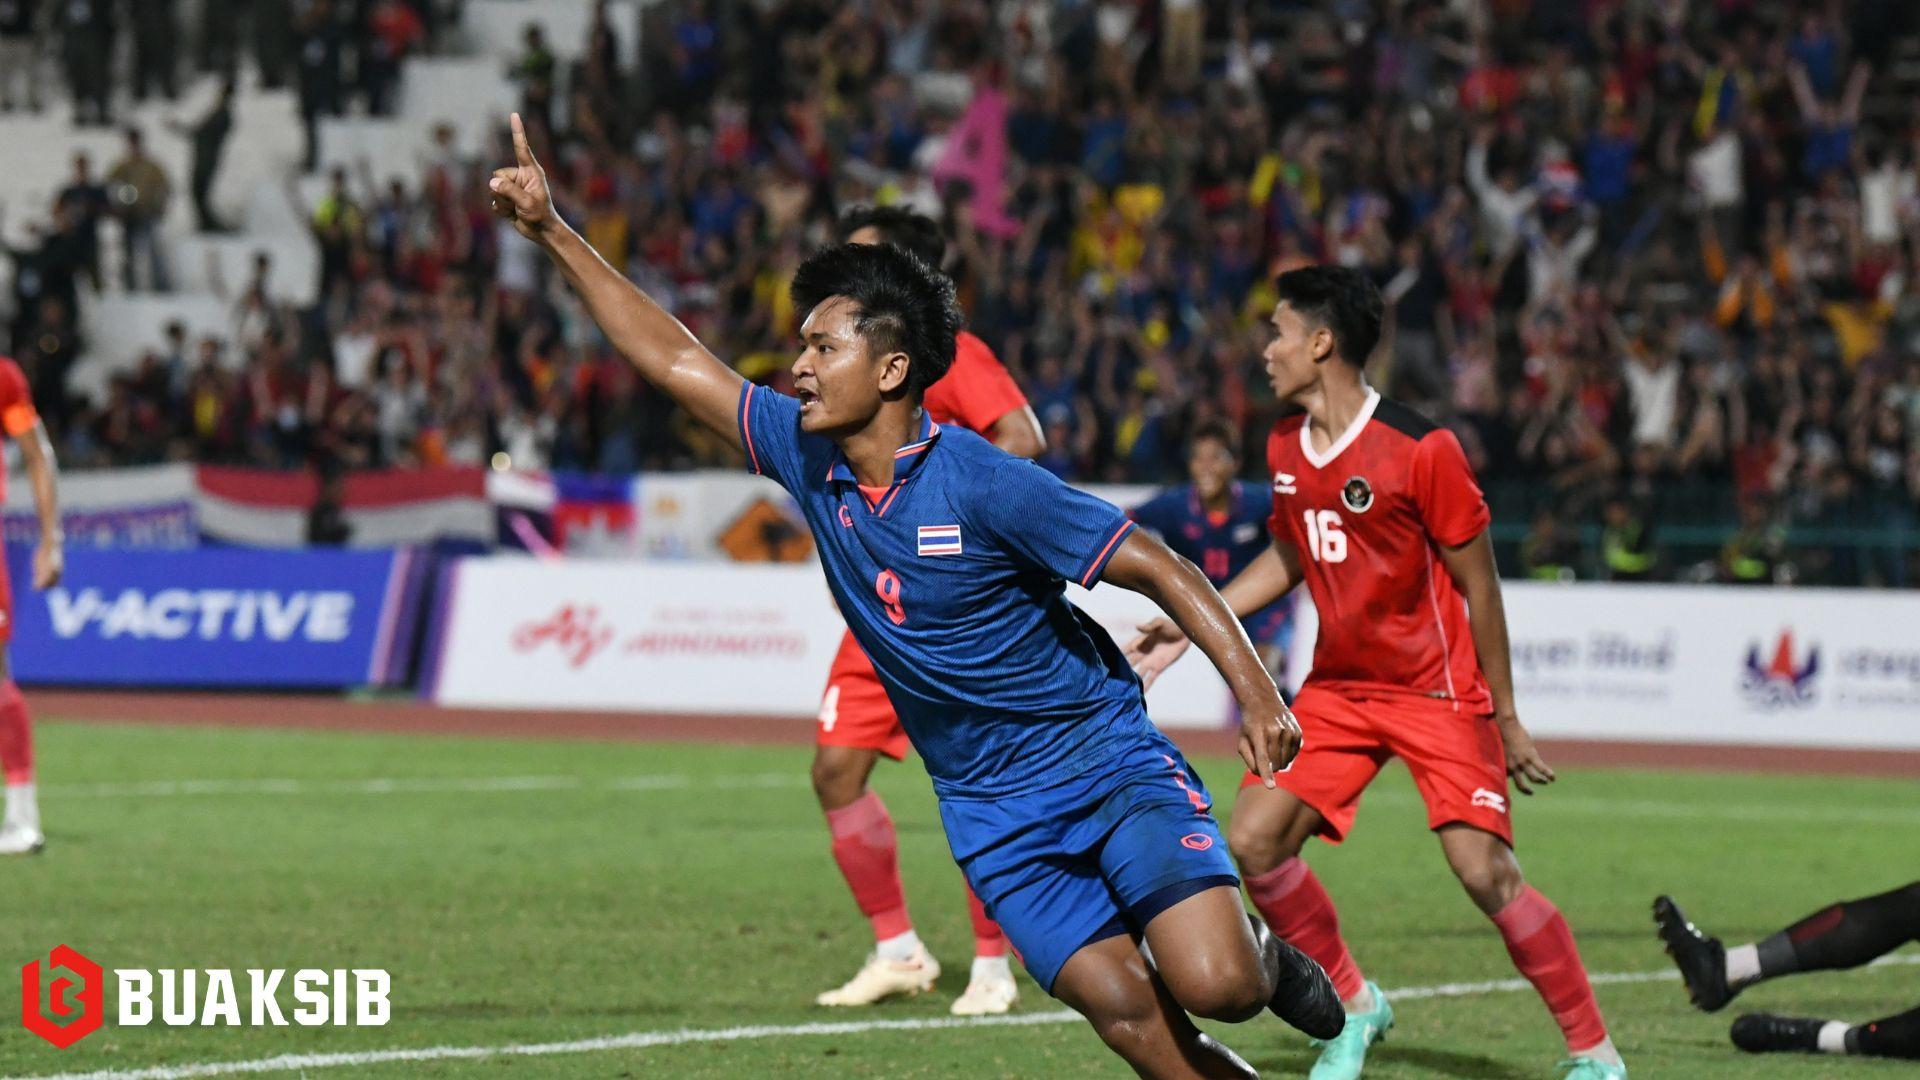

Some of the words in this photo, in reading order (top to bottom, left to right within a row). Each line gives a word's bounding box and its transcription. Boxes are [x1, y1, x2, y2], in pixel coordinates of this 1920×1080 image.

[1303, 509, 1347, 563] 16
[46, 588, 355, 642] V-ACTIVE
[875, 568, 906, 625] 9
